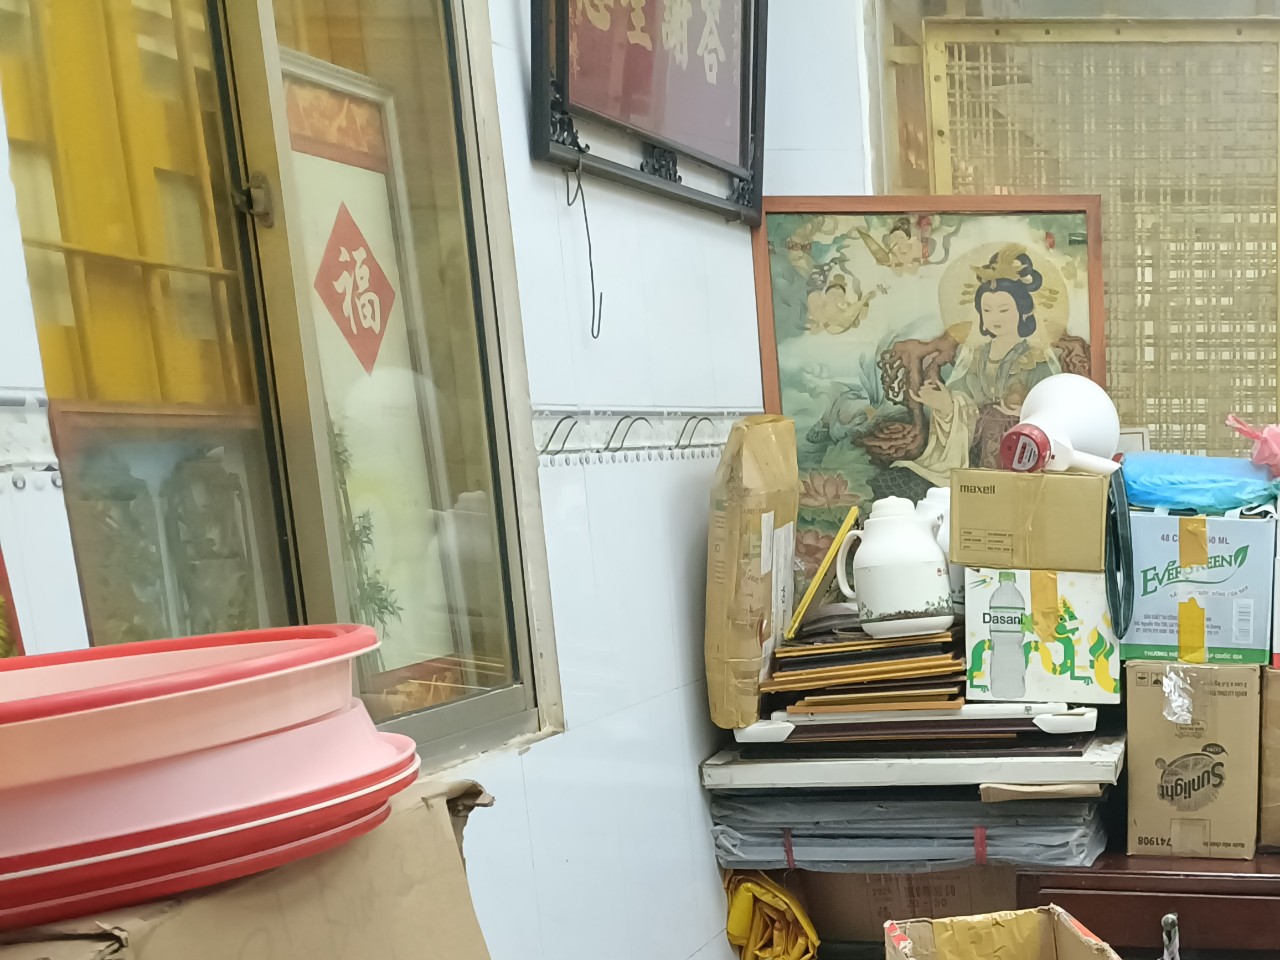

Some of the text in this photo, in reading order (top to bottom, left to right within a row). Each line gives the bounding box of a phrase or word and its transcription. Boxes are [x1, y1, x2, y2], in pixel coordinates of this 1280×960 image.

[333, 247, 381, 335] 福
[960, 484, 996, 495] maxell
[1218, 537, 1230, 545] ML
[982, 612, 1024, 625] Dasani
[1159, 761, 1225, 801] Sunlight
[1138, 836, 1172, 847] 741908
